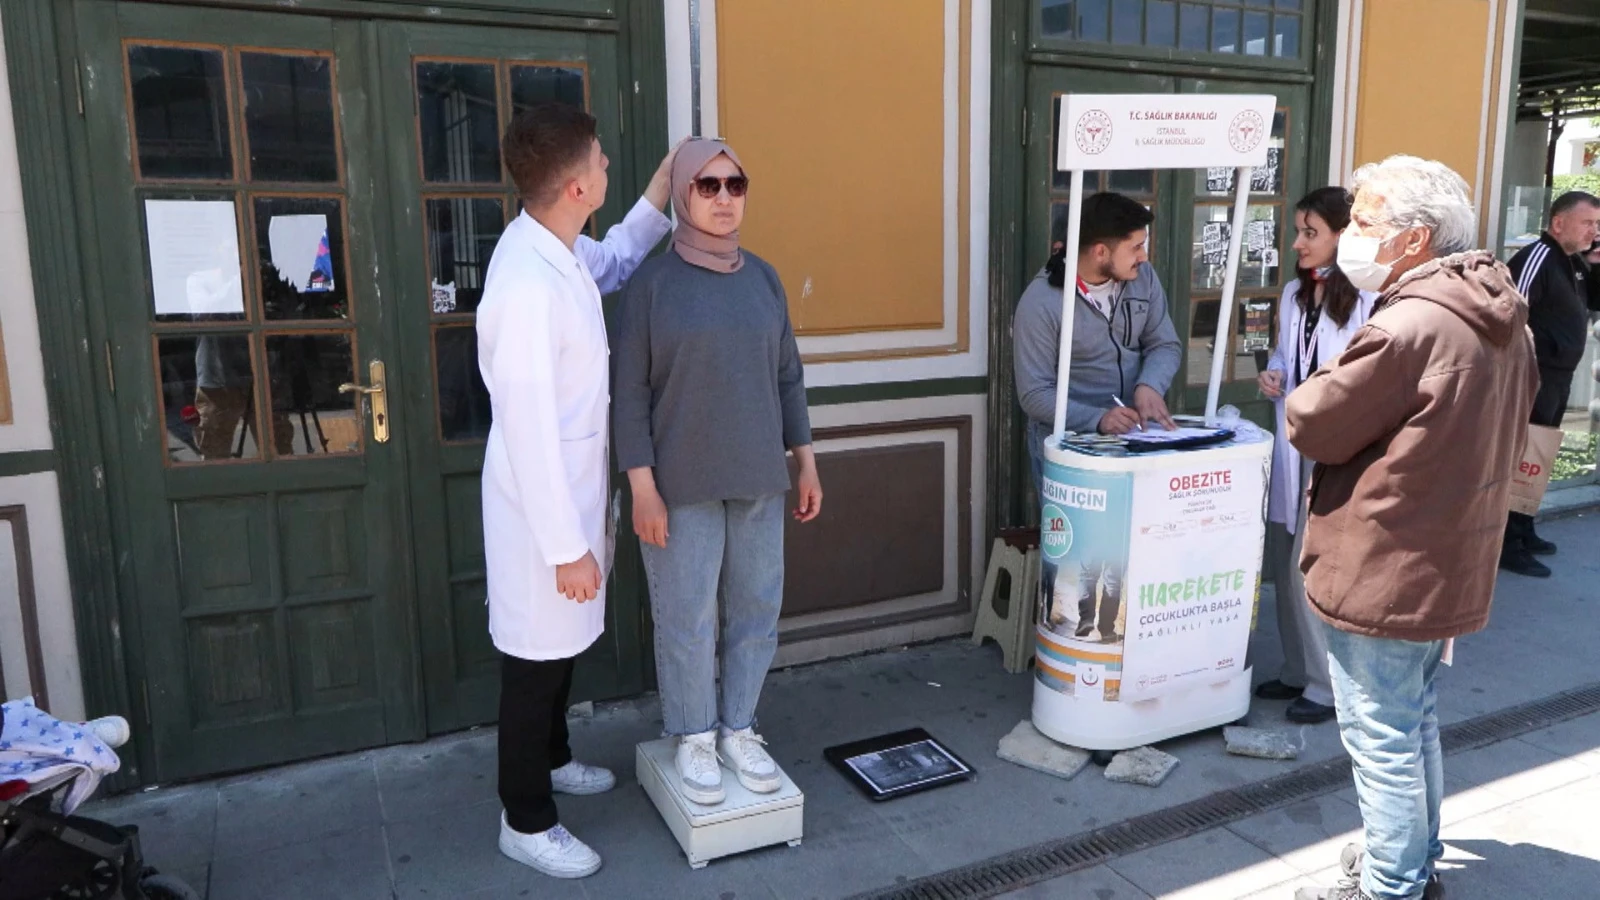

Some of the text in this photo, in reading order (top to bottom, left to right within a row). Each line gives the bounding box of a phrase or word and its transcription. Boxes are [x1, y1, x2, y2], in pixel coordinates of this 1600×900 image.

[1129, 110, 1217, 120] T.C. SAĞLIK BAKANLIĞI
[1156, 127, 1187, 135] İSTANBUL
[1142, 137, 1163, 145] SAĞLIK
[1071, 488, 1104, 509] İÇİN
[1169, 489, 1192, 500] SAĞLIK
[1139, 569, 1246, 609] HAREKETE
[1139, 597, 1241, 628] ÇOCUKLUKTA BAŞLA
[1138, 613, 1239, 640] SAĞLIKLI YAŞA
